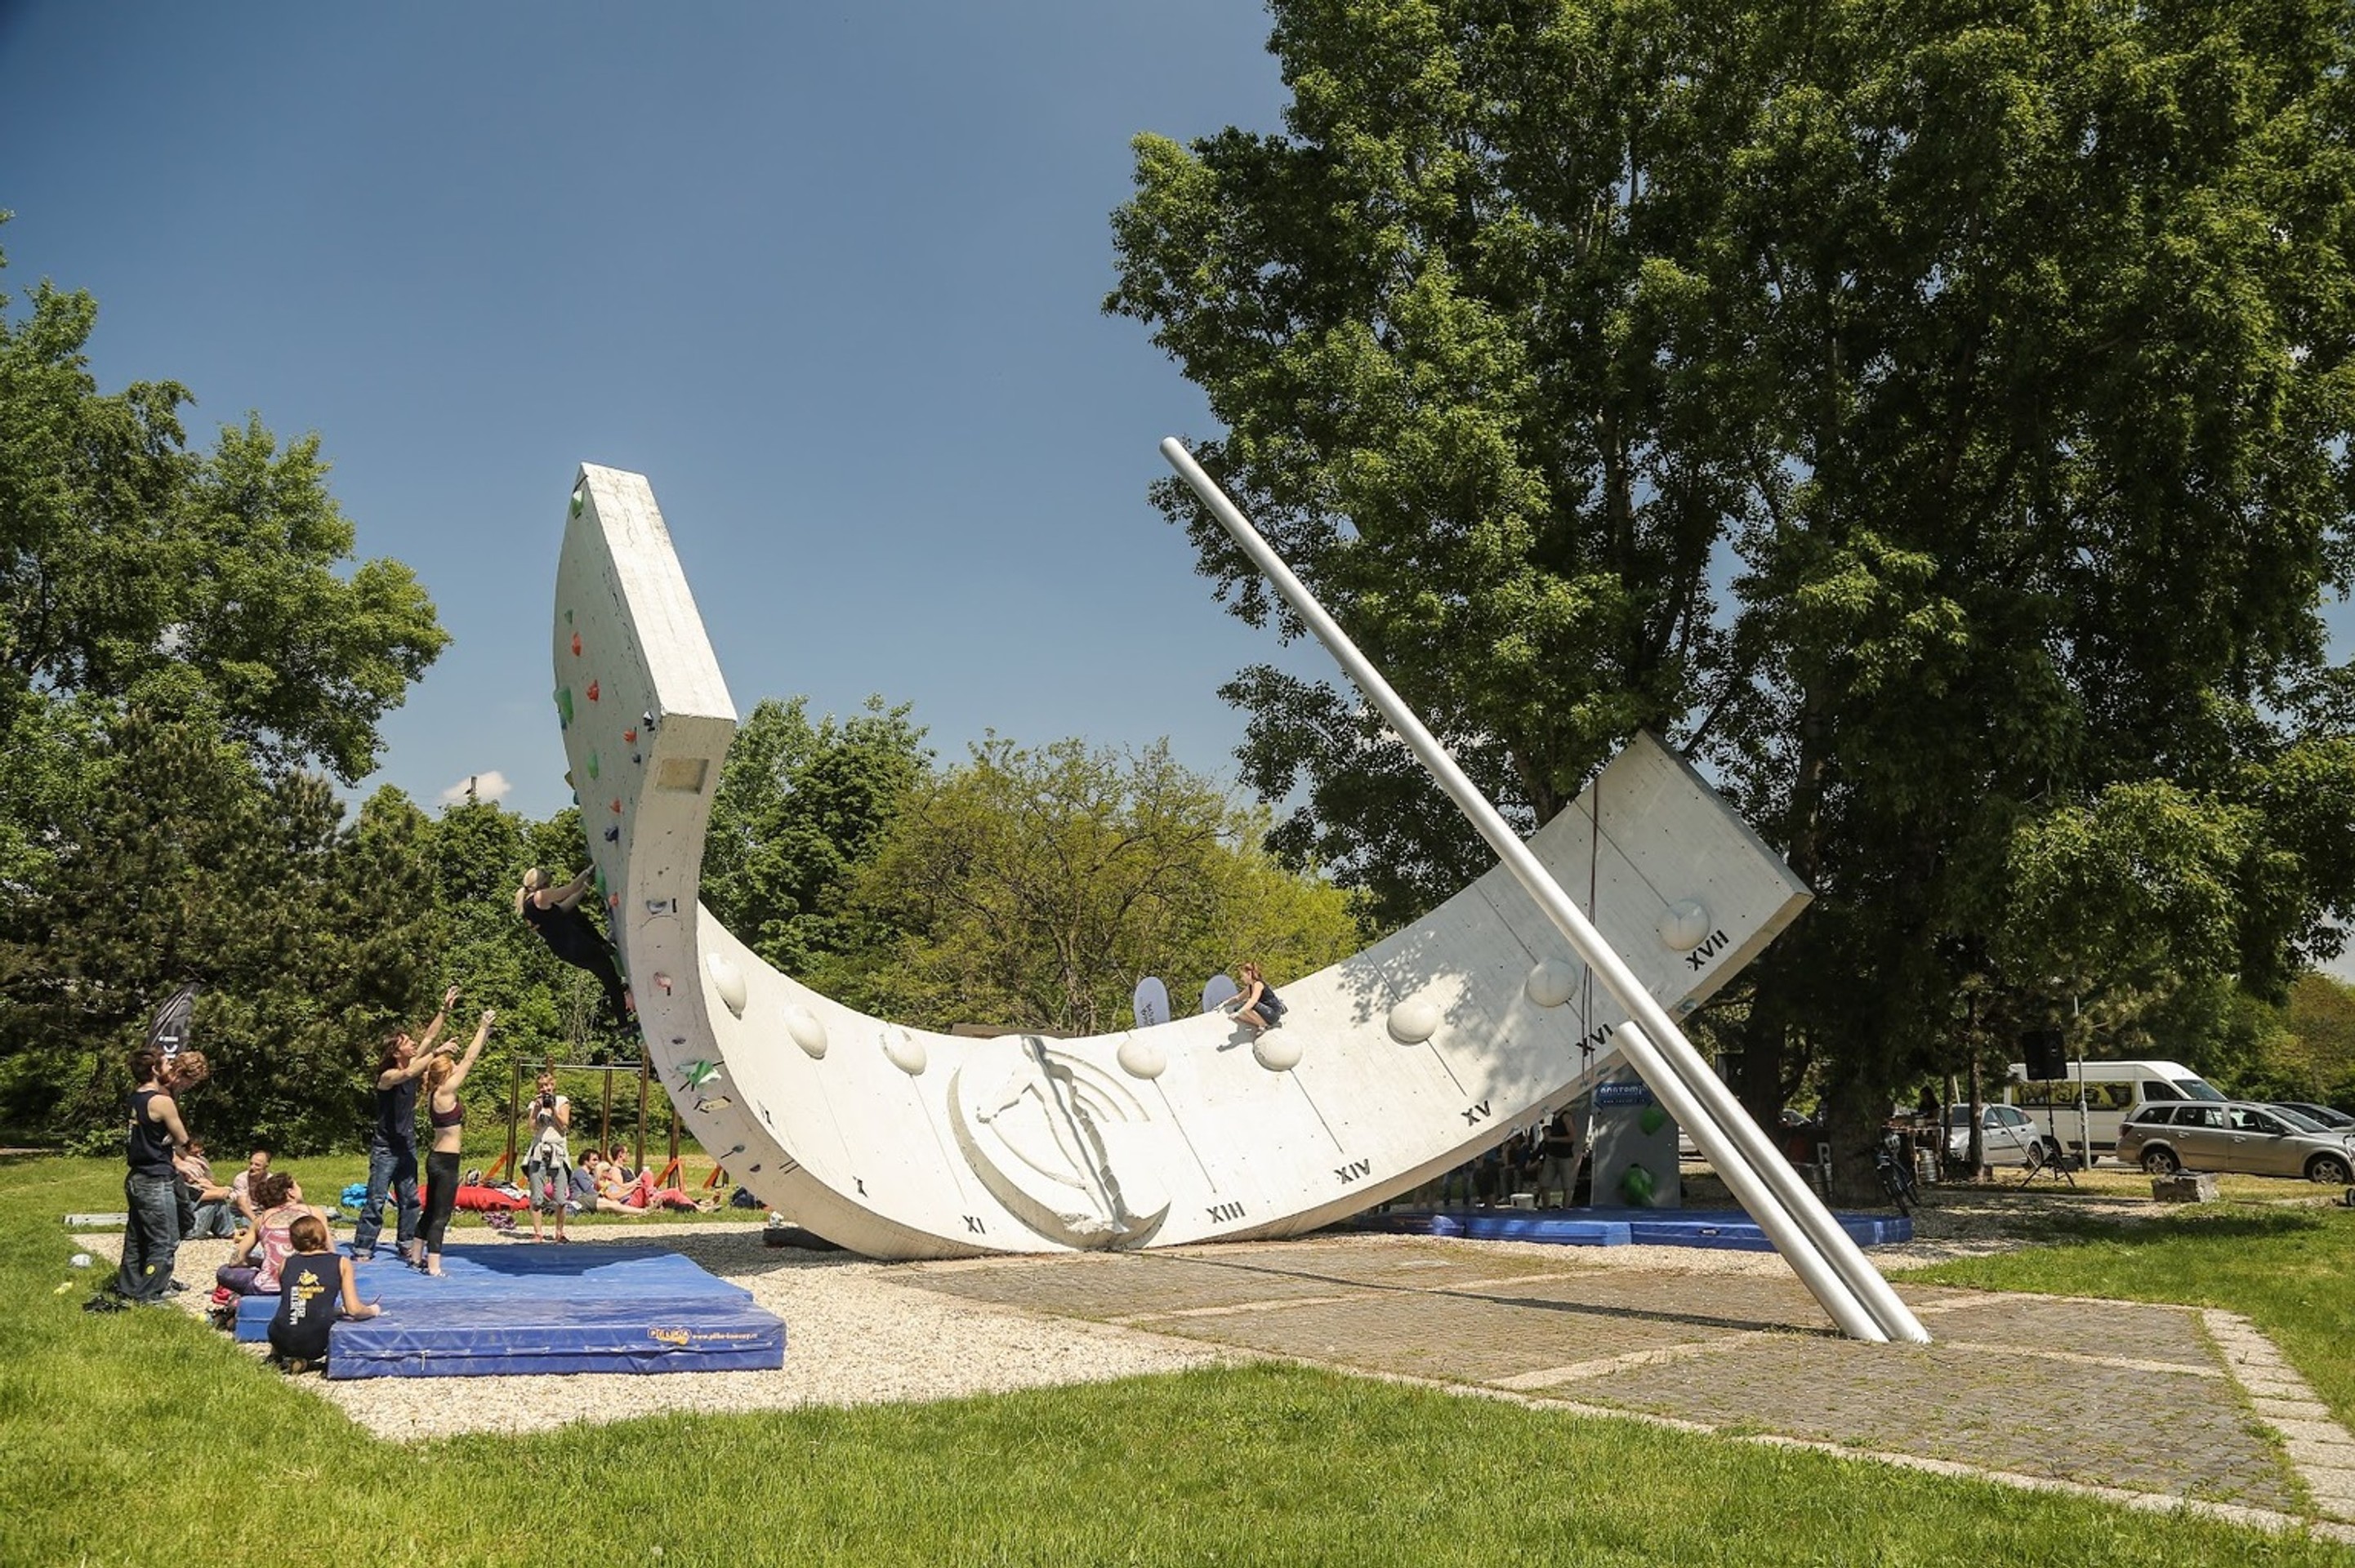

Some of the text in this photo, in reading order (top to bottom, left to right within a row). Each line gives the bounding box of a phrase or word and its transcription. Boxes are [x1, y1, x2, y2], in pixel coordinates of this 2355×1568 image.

[1685, 929, 1729, 972] XVII
[1575, 1023, 1614, 1057] XVI
[1461, 1099, 1491, 1127] XV
[1333, 1158, 1370, 1184] XIV
[962, 1215, 985, 1234] XI
[1206, 1201, 1246, 1223] XIII
